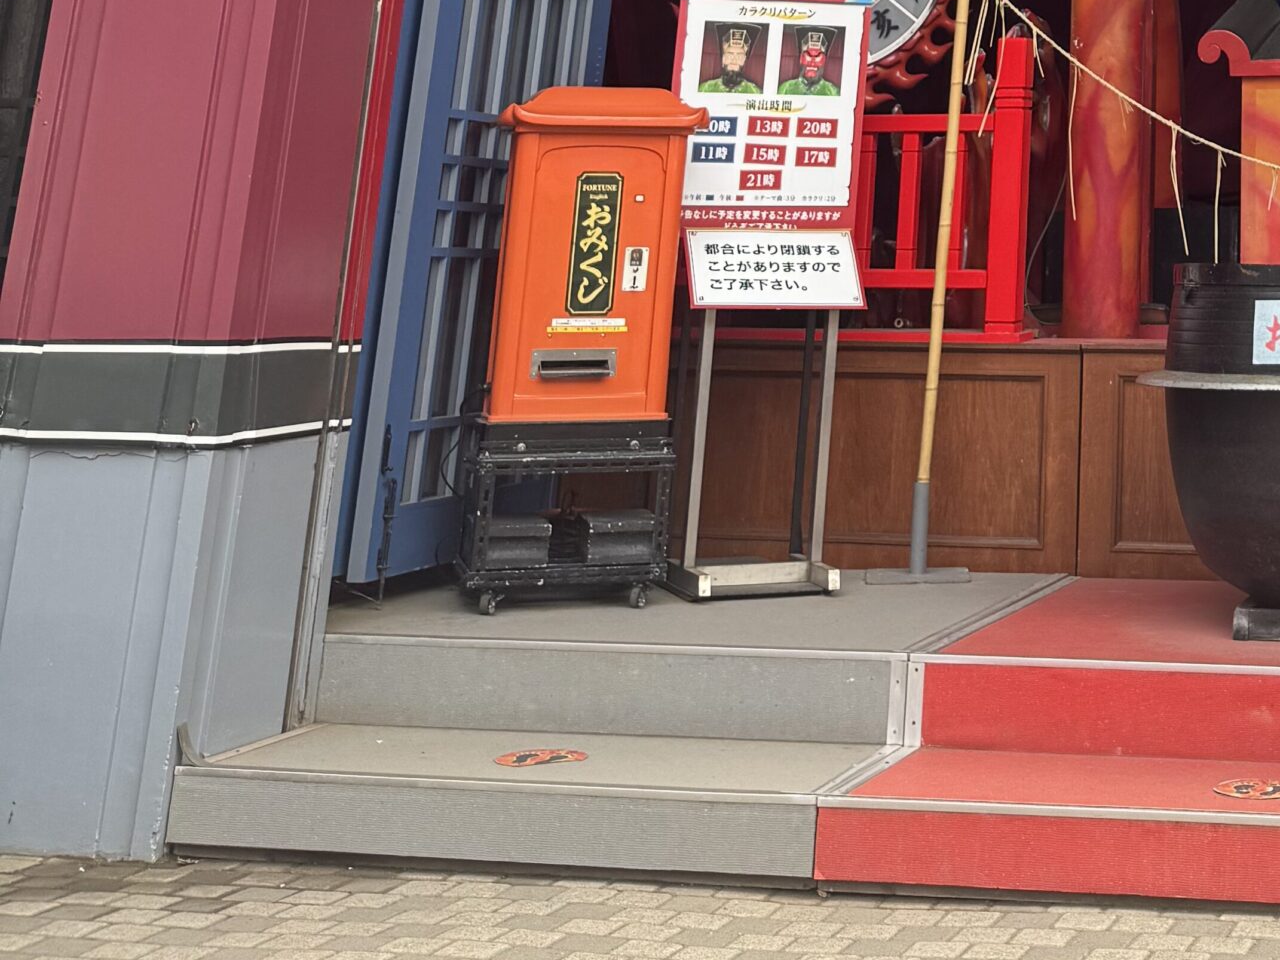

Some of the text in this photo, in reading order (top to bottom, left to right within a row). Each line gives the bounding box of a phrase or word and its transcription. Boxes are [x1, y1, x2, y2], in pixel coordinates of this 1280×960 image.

[738, 6, 816, 18] カラクリパターン
[745, 99, 792, 112] 演出時間
[704, 120, 832, 135] 0時 13時 20時
[699, 147, 830, 164] 11時 15時 17時
[746, 175, 775, 188] 21時
[577, 202, 612, 304] おみくじ
[704, 244, 840, 256] 都合により閉鎖する
[708, 261, 841, 273] ことがありますので
[710, 279, 808, 291] ご了承下さい。
